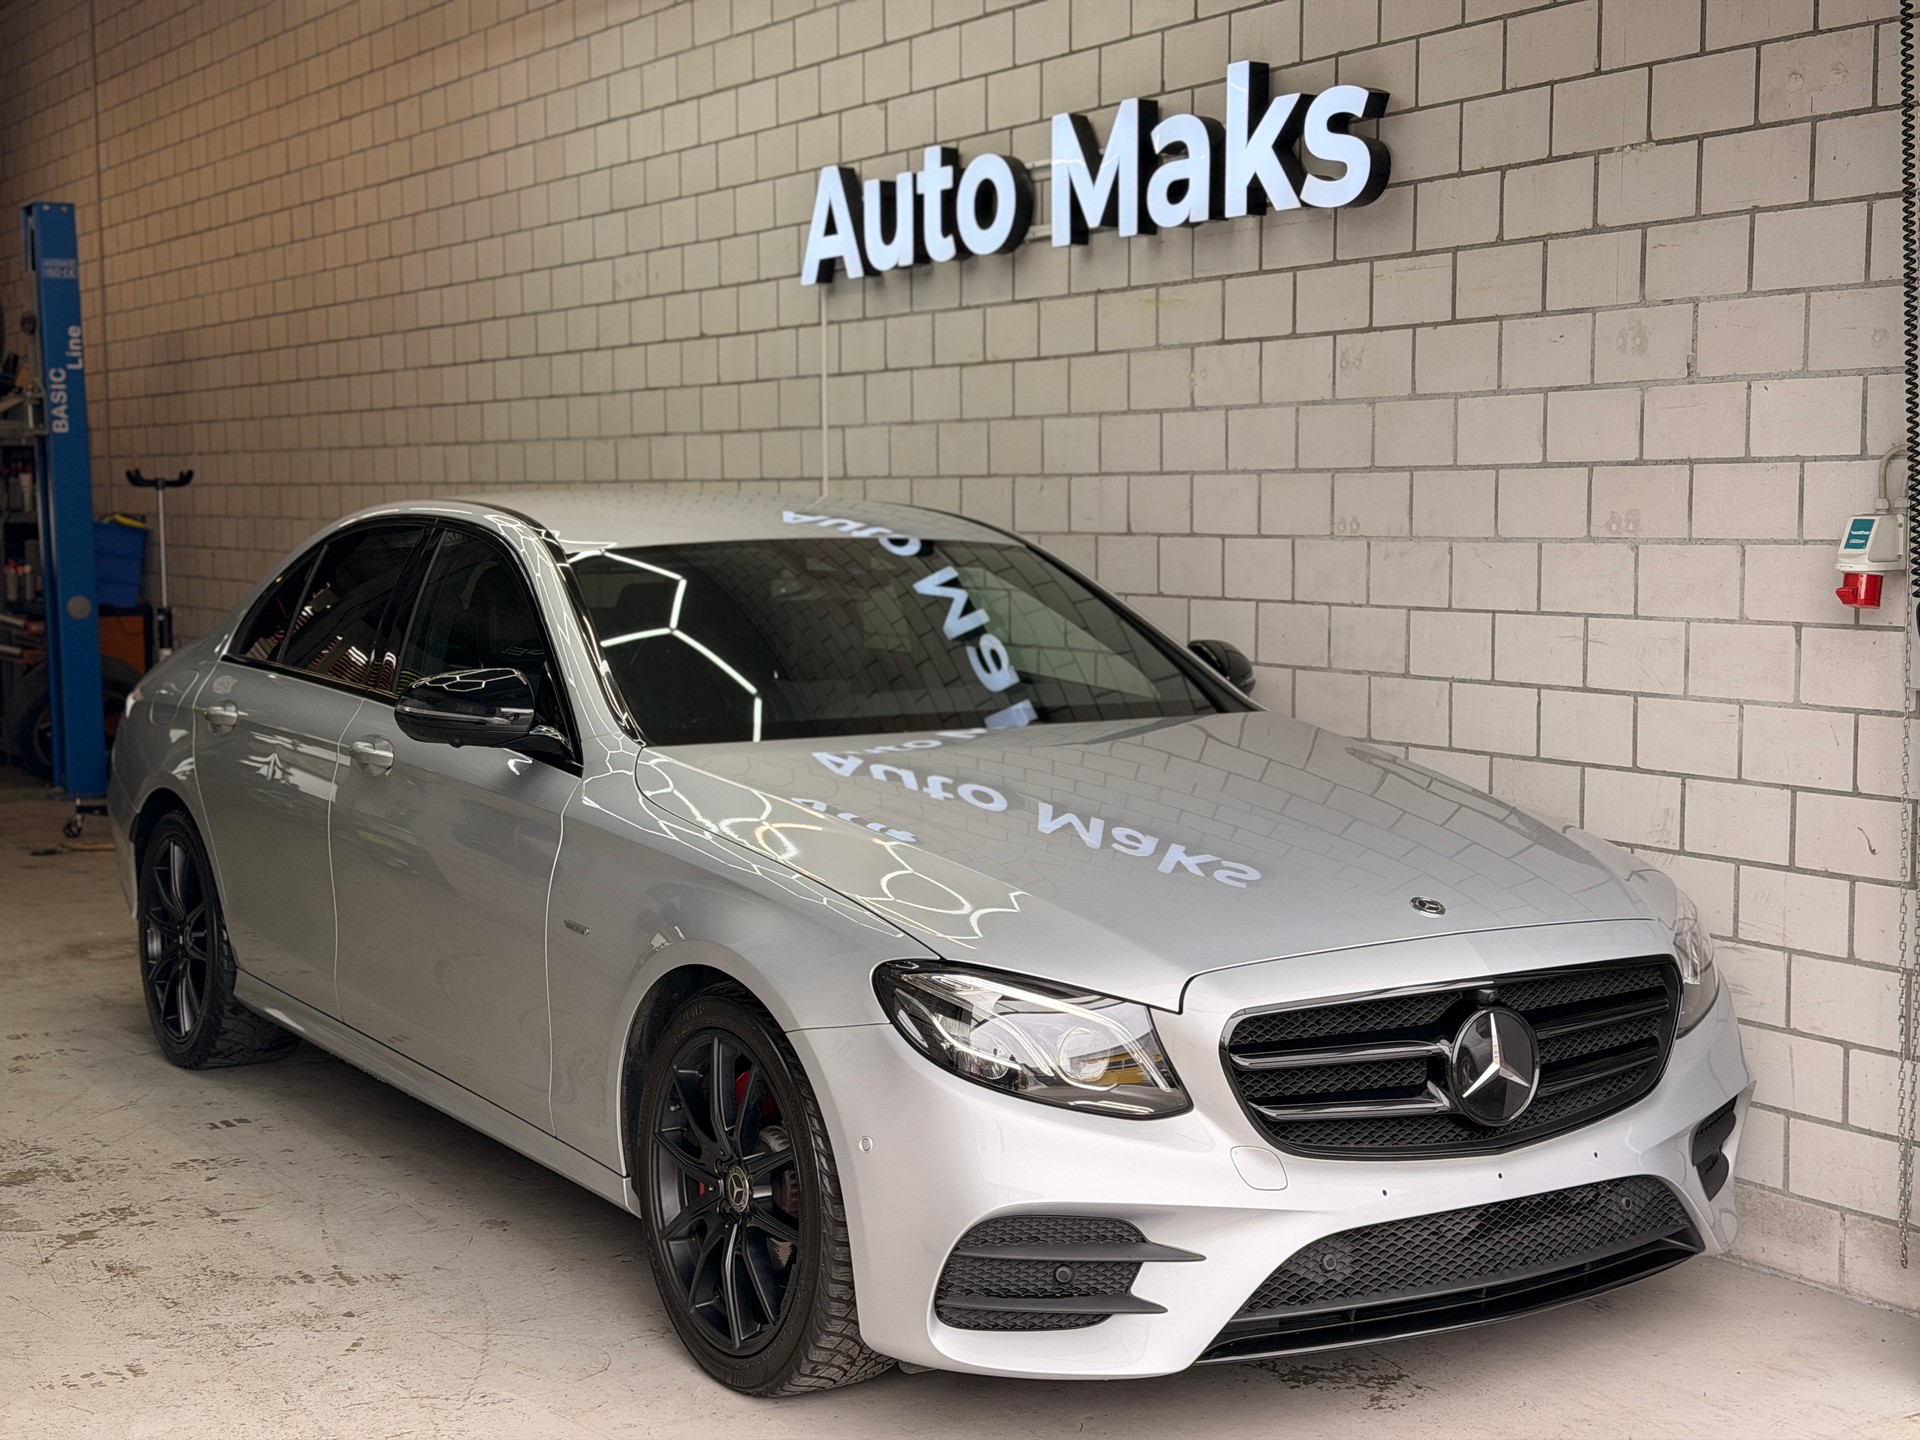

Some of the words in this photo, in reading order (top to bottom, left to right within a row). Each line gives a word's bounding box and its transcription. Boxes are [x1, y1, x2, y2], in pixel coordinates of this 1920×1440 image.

[800, 145, 1018, 287] Auto
[1051, 59, 1374, 248] Maks
[65, 325, 83, 370] Line
[48, 367, 70, 433] BASIC
